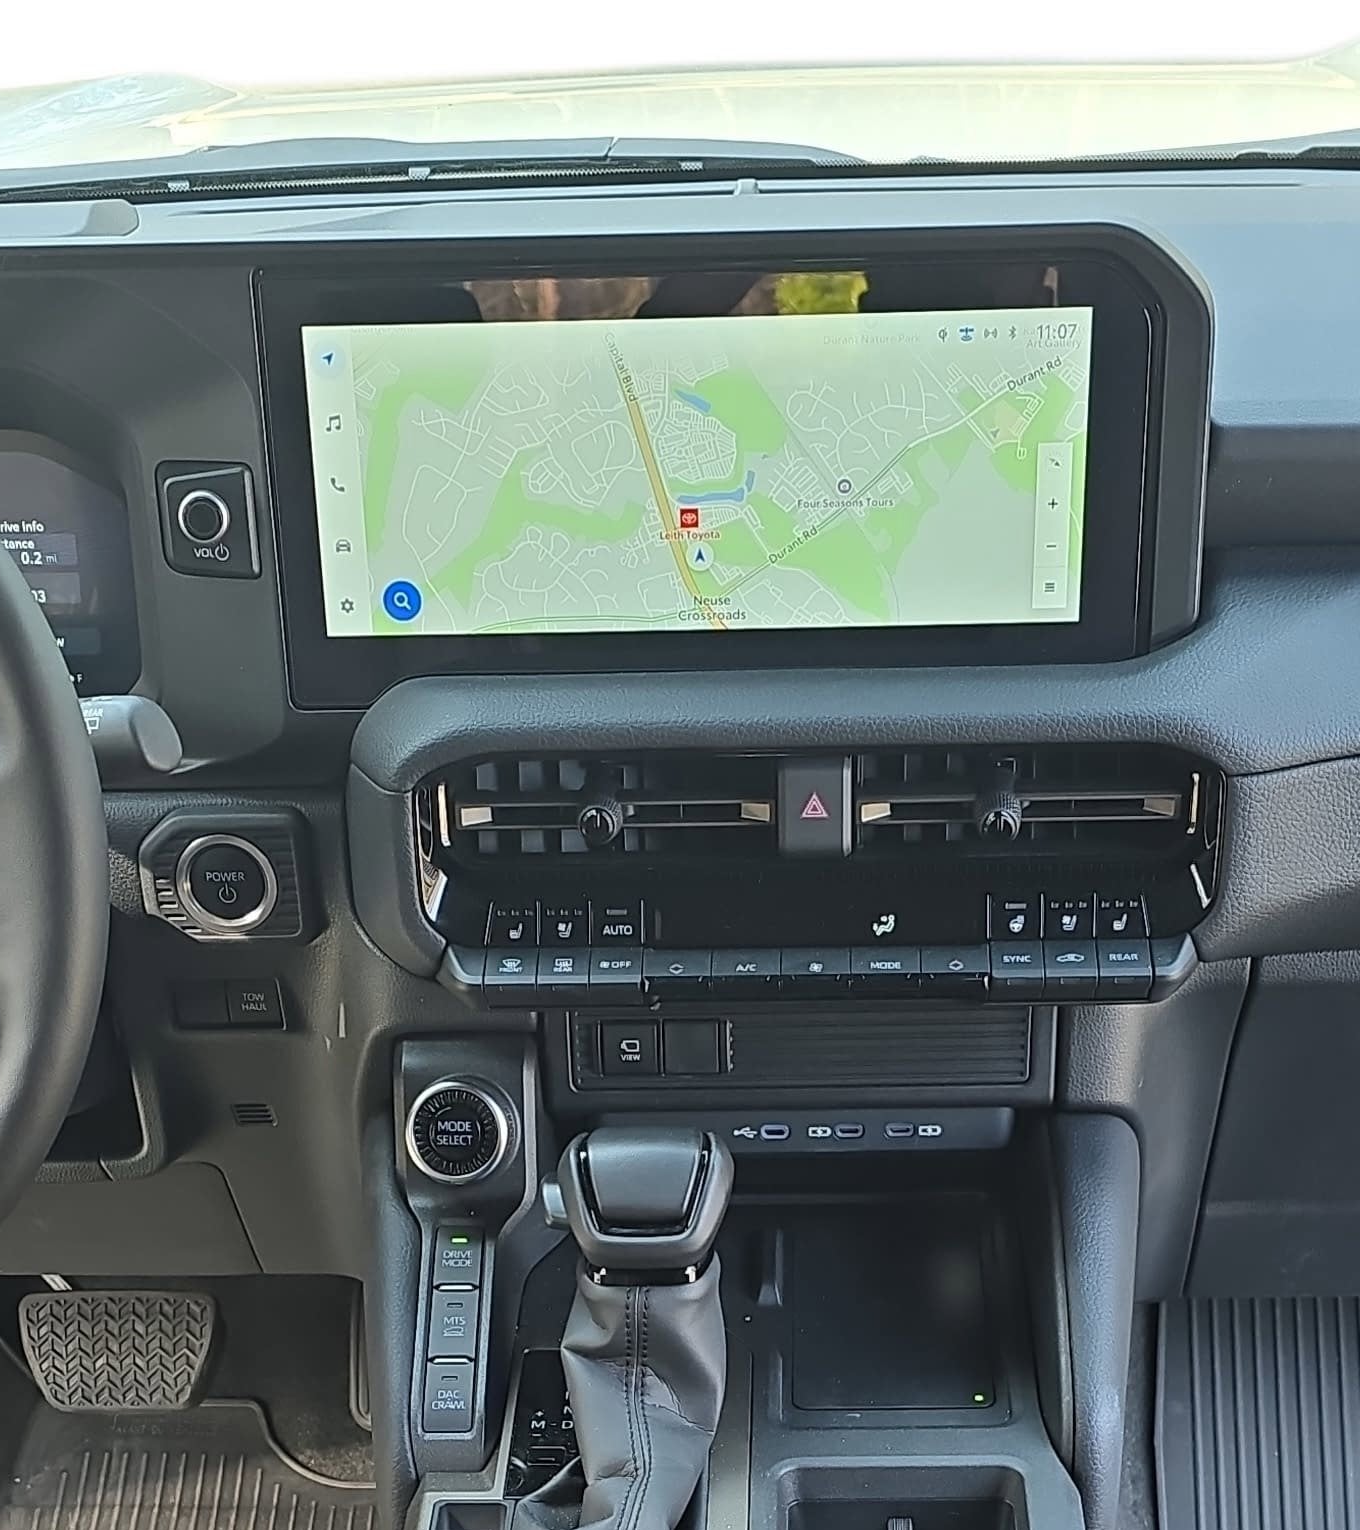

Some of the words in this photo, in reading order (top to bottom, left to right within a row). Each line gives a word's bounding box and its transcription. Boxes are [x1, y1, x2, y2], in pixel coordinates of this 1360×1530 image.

[1037, 324, 1077, 339] 11:07
[605, 332, 629, 375] Capital
[622, 375, 639, 402] Blvd
[1007, 366, 1046, 391] Durant
[1046, 356, 1062, 372] Rd
[797, 499, 820, 509] Four
[822, 499, 864, 509] Seasons
[866, 498, 894, 507] Tours
[21, 520, 45, 532] Info
[659, 531, 684, 541] Leith
[686, 530, 720, 540] Toyota
[768, 537, 803, 564] Durant
[802, 526, 818, 541] Rd
[20, 551, 43, 565] 0.2
[46, 553, 57, 563] mi
[194, 548, 214, 558] VOL
[693, 596, 731, 606] Neuse
[678, 609, 747, 621] Crossroads
[205, 871, 245, 882] POWER
[602, 924, 633, 936] AUTO
[1002, 954, 1032, 963] SYNC
[1108, 953, 1139, 961] REAR
[611, 960, 633, 969] OFF
[735, 963, 757, 972] A/C
[870, 961, 902, 970] MODE
[242, 992, 265, 1001] TOW
[241, 1002, 267, 1011] HAUL
[620, 1053, 641, 1062] VIEW
[437, 1120, 473, 1132] MODE
[436, 1134, 473, 1146] SELECT
[443, 1250, 473, 1259] DRIVE
[441, 1259, 473, 1268] MODE
[443, 1316, 467, 1326] MTS
[437, 1390, 460, 1399] DAC
[431, 1400, 467, 1410] CRAWL
[530, 1420, 546, 1429] M
[562, 1420, 574, 1429] D
